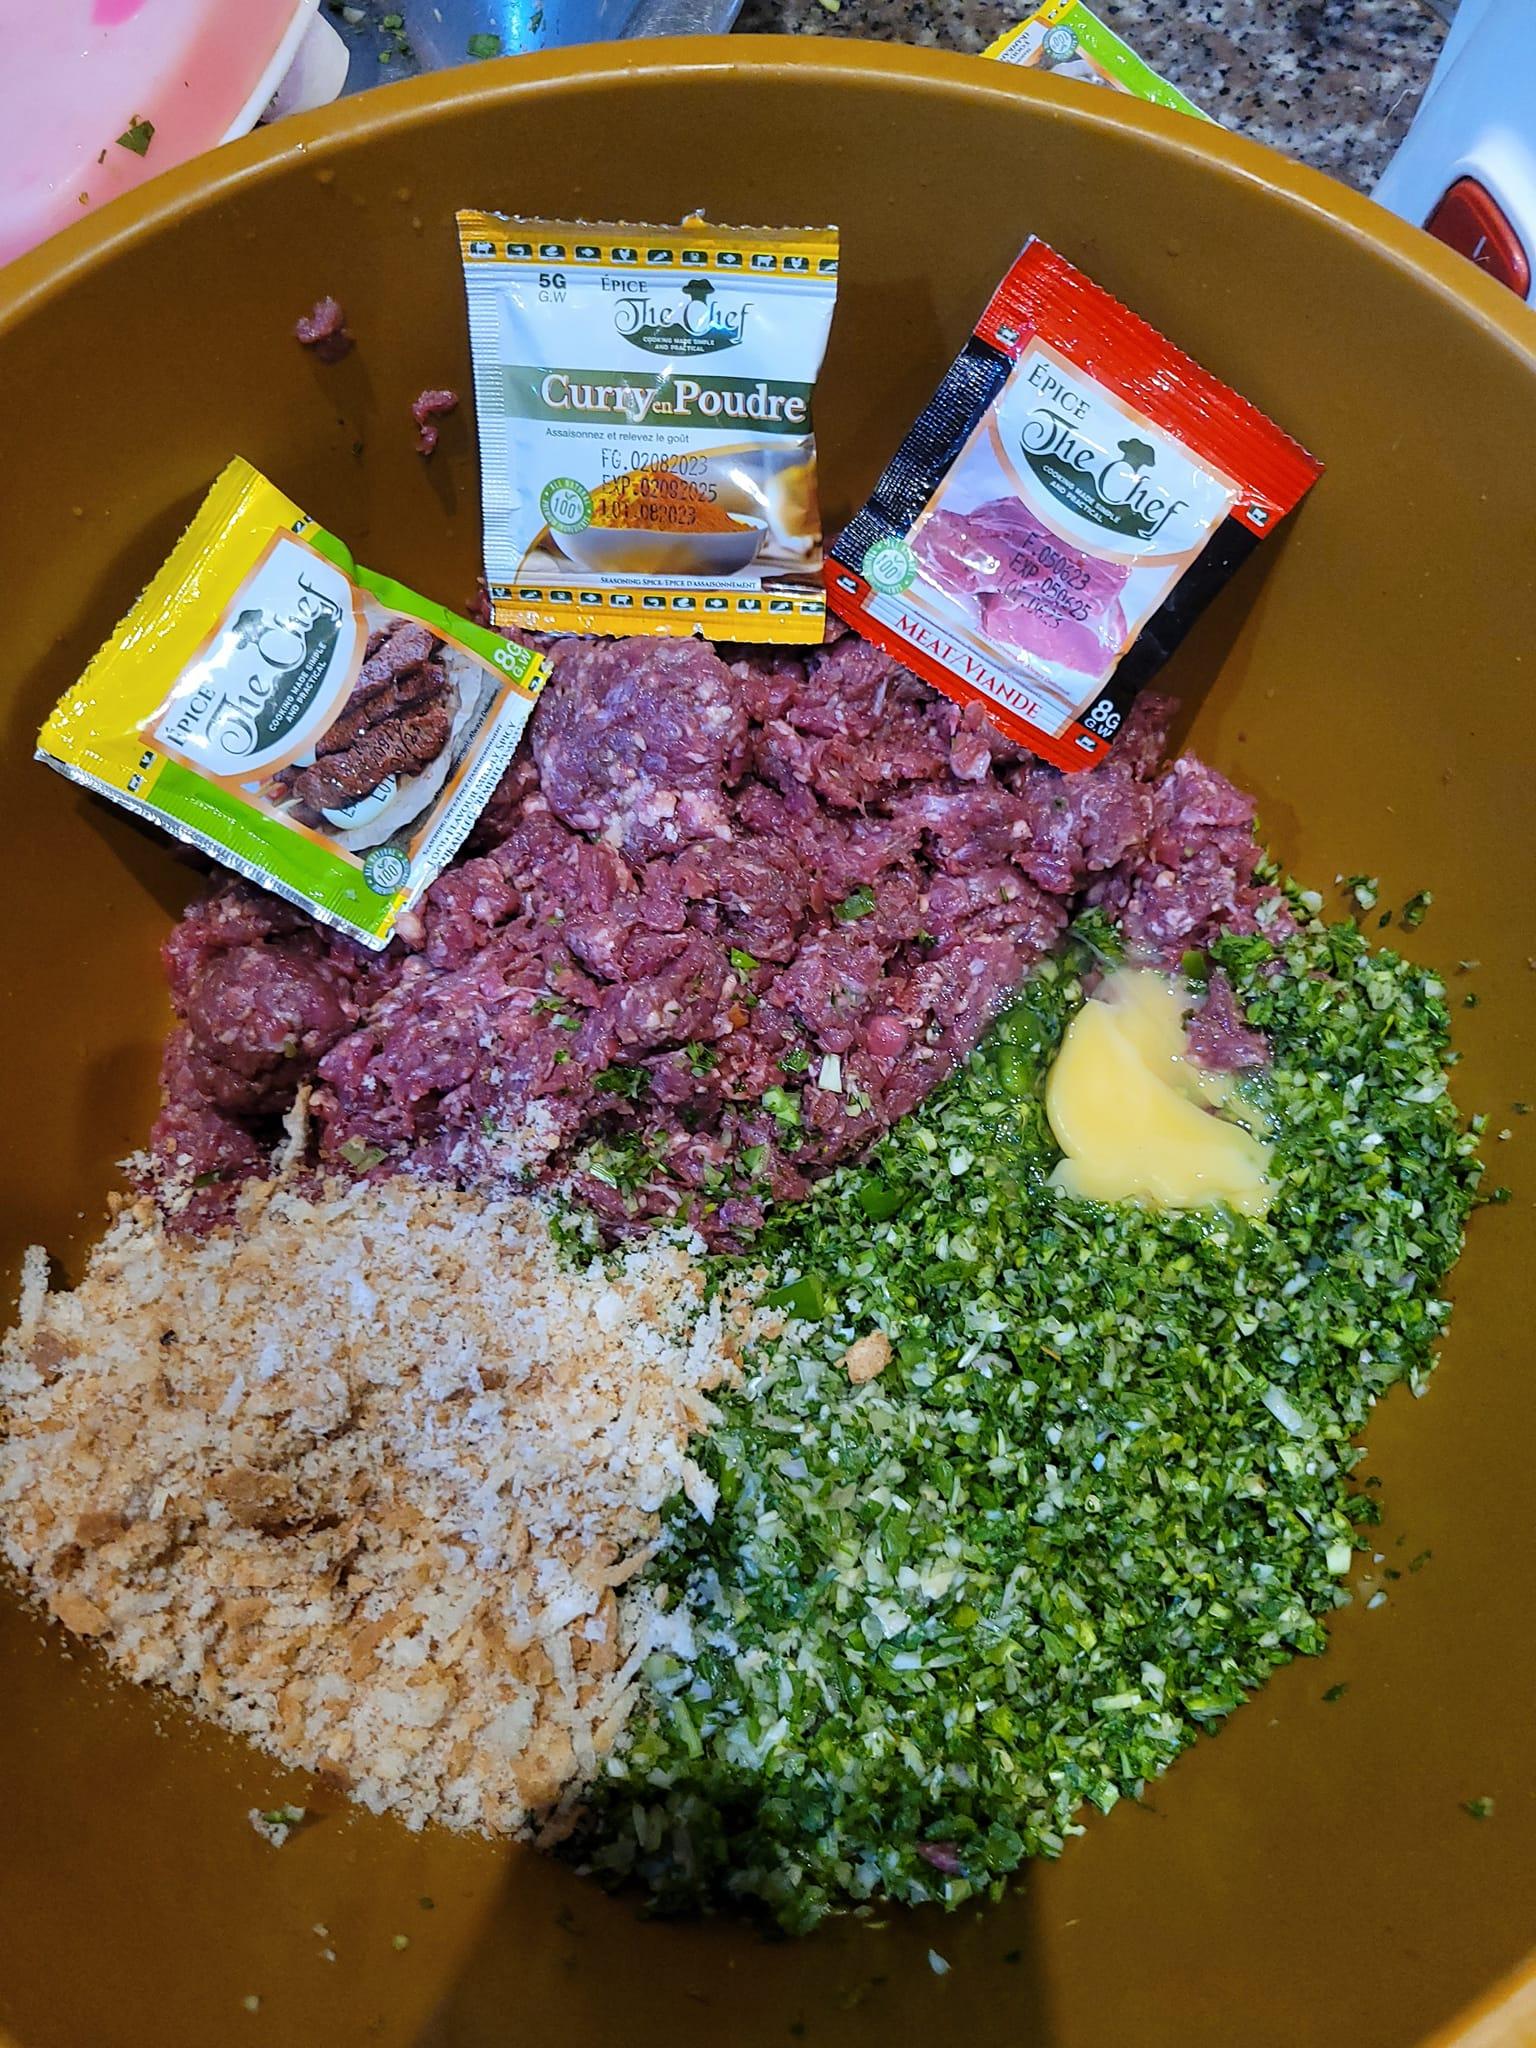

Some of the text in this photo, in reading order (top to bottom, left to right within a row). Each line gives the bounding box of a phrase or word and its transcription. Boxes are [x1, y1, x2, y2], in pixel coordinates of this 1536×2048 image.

[538, 291, 567, 303] G.W
[539, 273, 567, 289] 5G
[601, 274, 648, 293] ÉPICE
[614, 297, 756, 344] The Chef
[541, 374, 807, 424] Curry en Poudre
[1027, 363, 1090, 420] ÉPICE
[546, 428, 689, 444] Assaisonnez et relevez le goût
[1021, 408, 1190, 538] The Chef
[205, 571, 343, 756] The Chef
[268, 641, 328, 733] COOKING MADE SIMPLE
[895, 613, 1043, 720] MEAT/VIANDE
[165, 681, 217, 748] ÉPICE
[286, 660, 328, 724] AND PRACTICAL
[1090, 699, 1122, 731] 8G
[1083, 717, 1114, 739] G.W
